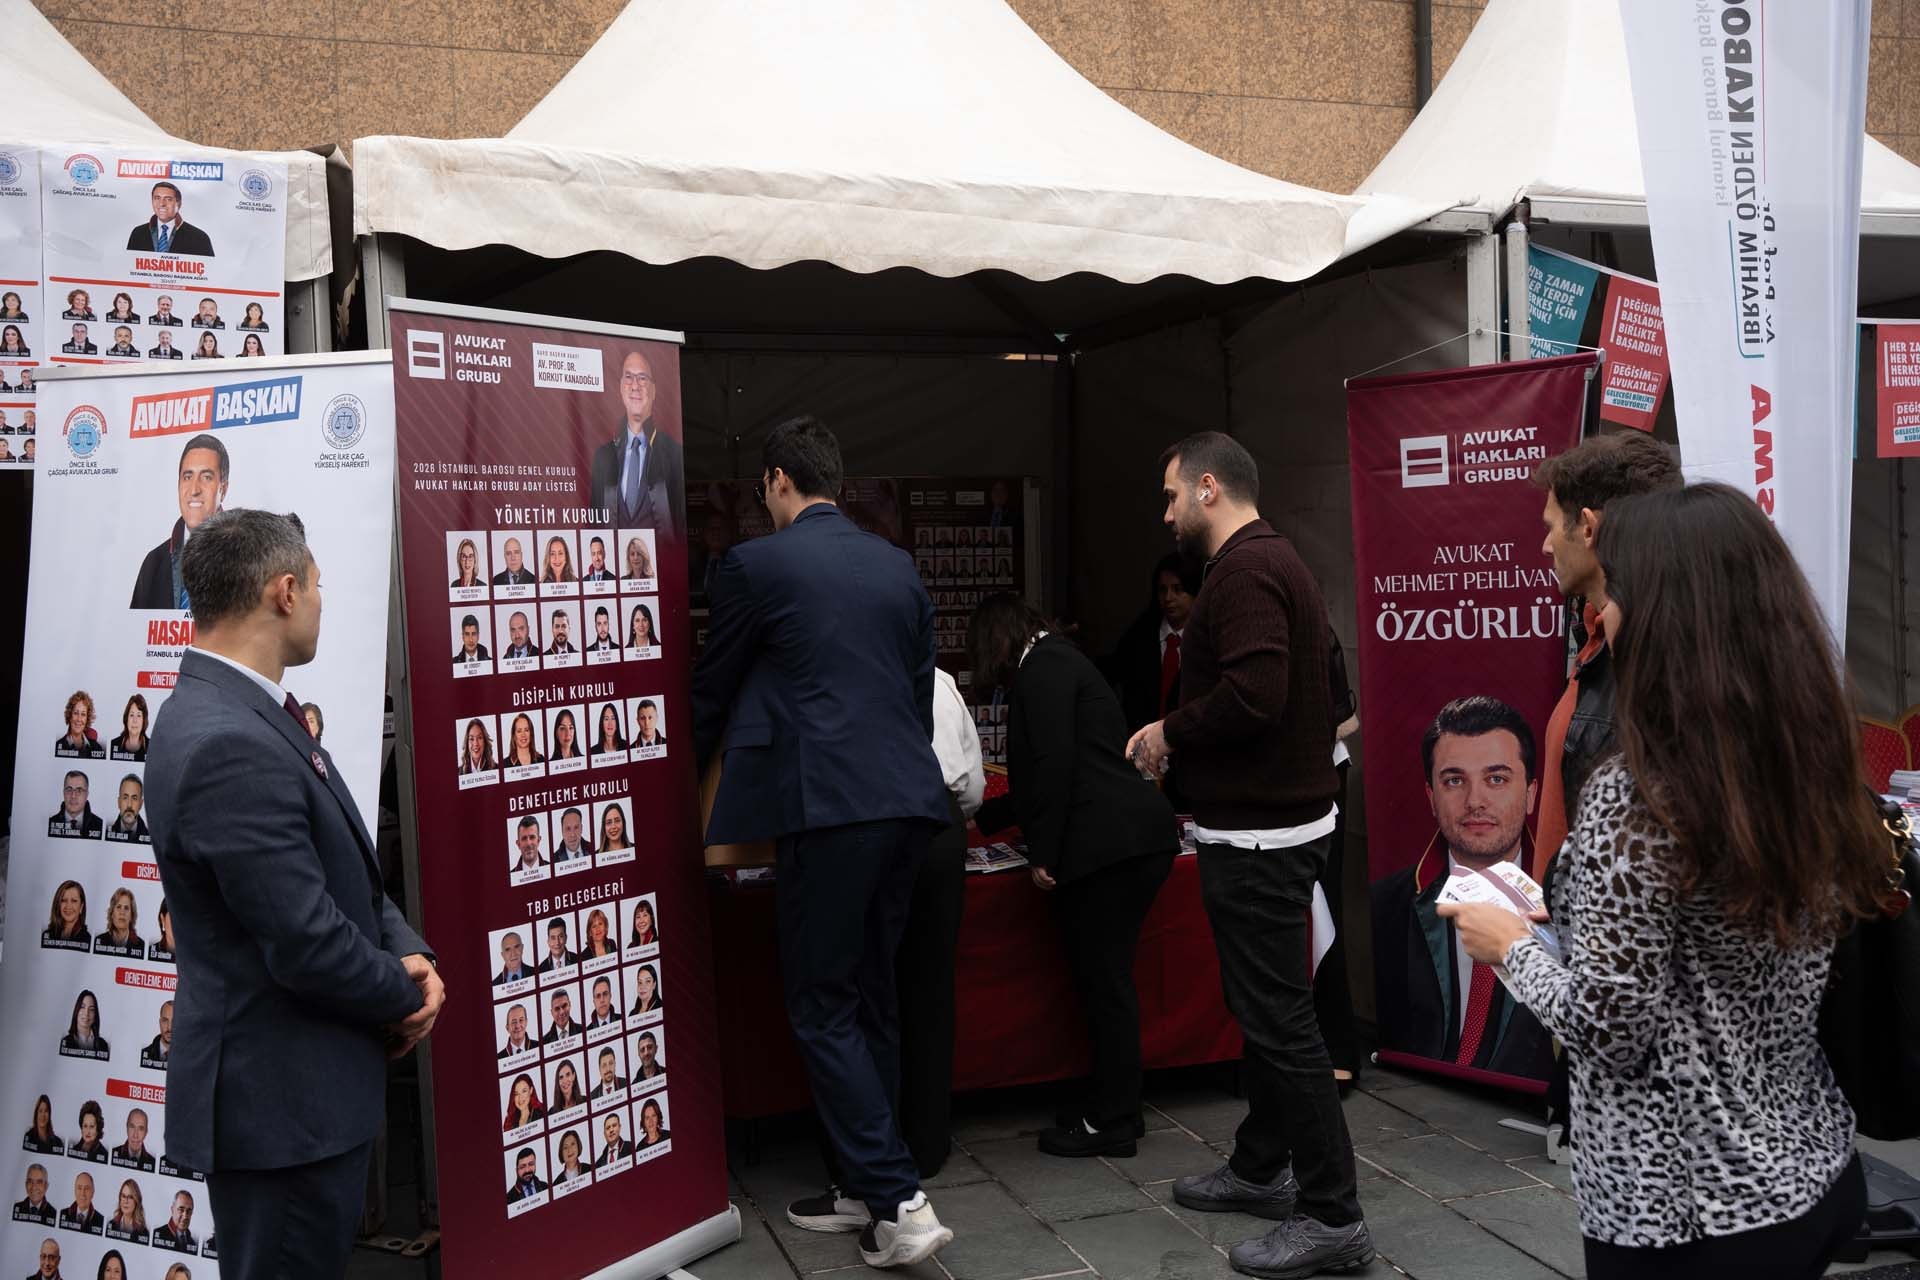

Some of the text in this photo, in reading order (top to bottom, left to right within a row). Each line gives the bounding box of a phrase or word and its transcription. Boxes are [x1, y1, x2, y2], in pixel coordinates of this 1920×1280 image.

[119, 162, 221, 180] AVUKAT BAŞKAN
[136, 258, 205, 276] HASAN KILIÇ
[1529, 280, 1576, 306] ER YERDE
[1545, 274, 1585, 297] ZAMAN
[1529, 291, 1578, 321] ERKES İÇİN
[1618, 322, 1657, 342] BİRLİKTE
[454, 334, 507, 350] AVUKAT
[1615, 334, 1663, 357] BAŞARDIK!
[1890, 342, 1907, 353] HER
[455, 352, 512, 368] HAKLARI
[538, 360, 577, 372] AV. PROF. DR.
[1890, 353, 1908, 364] HER
[456, 370, 501, 384] GRUBU
[538, 372, 600, 386] KORKUT KANADOĞLU
[1613, 364, 1651, 381] DEĞİŞİM
[1610, 376, 1658, 393] AVUKATLAR
[133, 383, 298, 432] AVUKAT BAŞKAN
[1462, 427, 1538, 445] AVUKAT
[69, 460, 85, 468] ÖNCE
[1463, 445, 1546, 465] HAKLARI
[413, 460, 576, 477] 2026 İSTANBUL BAROSU GENEL KURULU
[1464, 466, 1529, 485] GRUBU
[415, 479, 577, 492] AVUKAT HAKLARI GRUBU ADAY LİSTESİ
[495, 504, 610, 524] YÖNETİM KURULU
[1433, 543, 1514, 565] AVUKAT
[1374, 572, 1458, 593] MEHMET
[146, 649, 173, 658] İSTANBUL
[512, 681, 615, 706] DİSİPLİN KURULU
[509, 778, 629, 812] DENETLEME KURULU
[137, 864, 160, 879] DİSİPL
[527, 878, 624, 917] TBB DELEGELERİ
[124, 971, 177, 990] DENETLEME KUR
[129, 1085, 141, 1098] TBB
